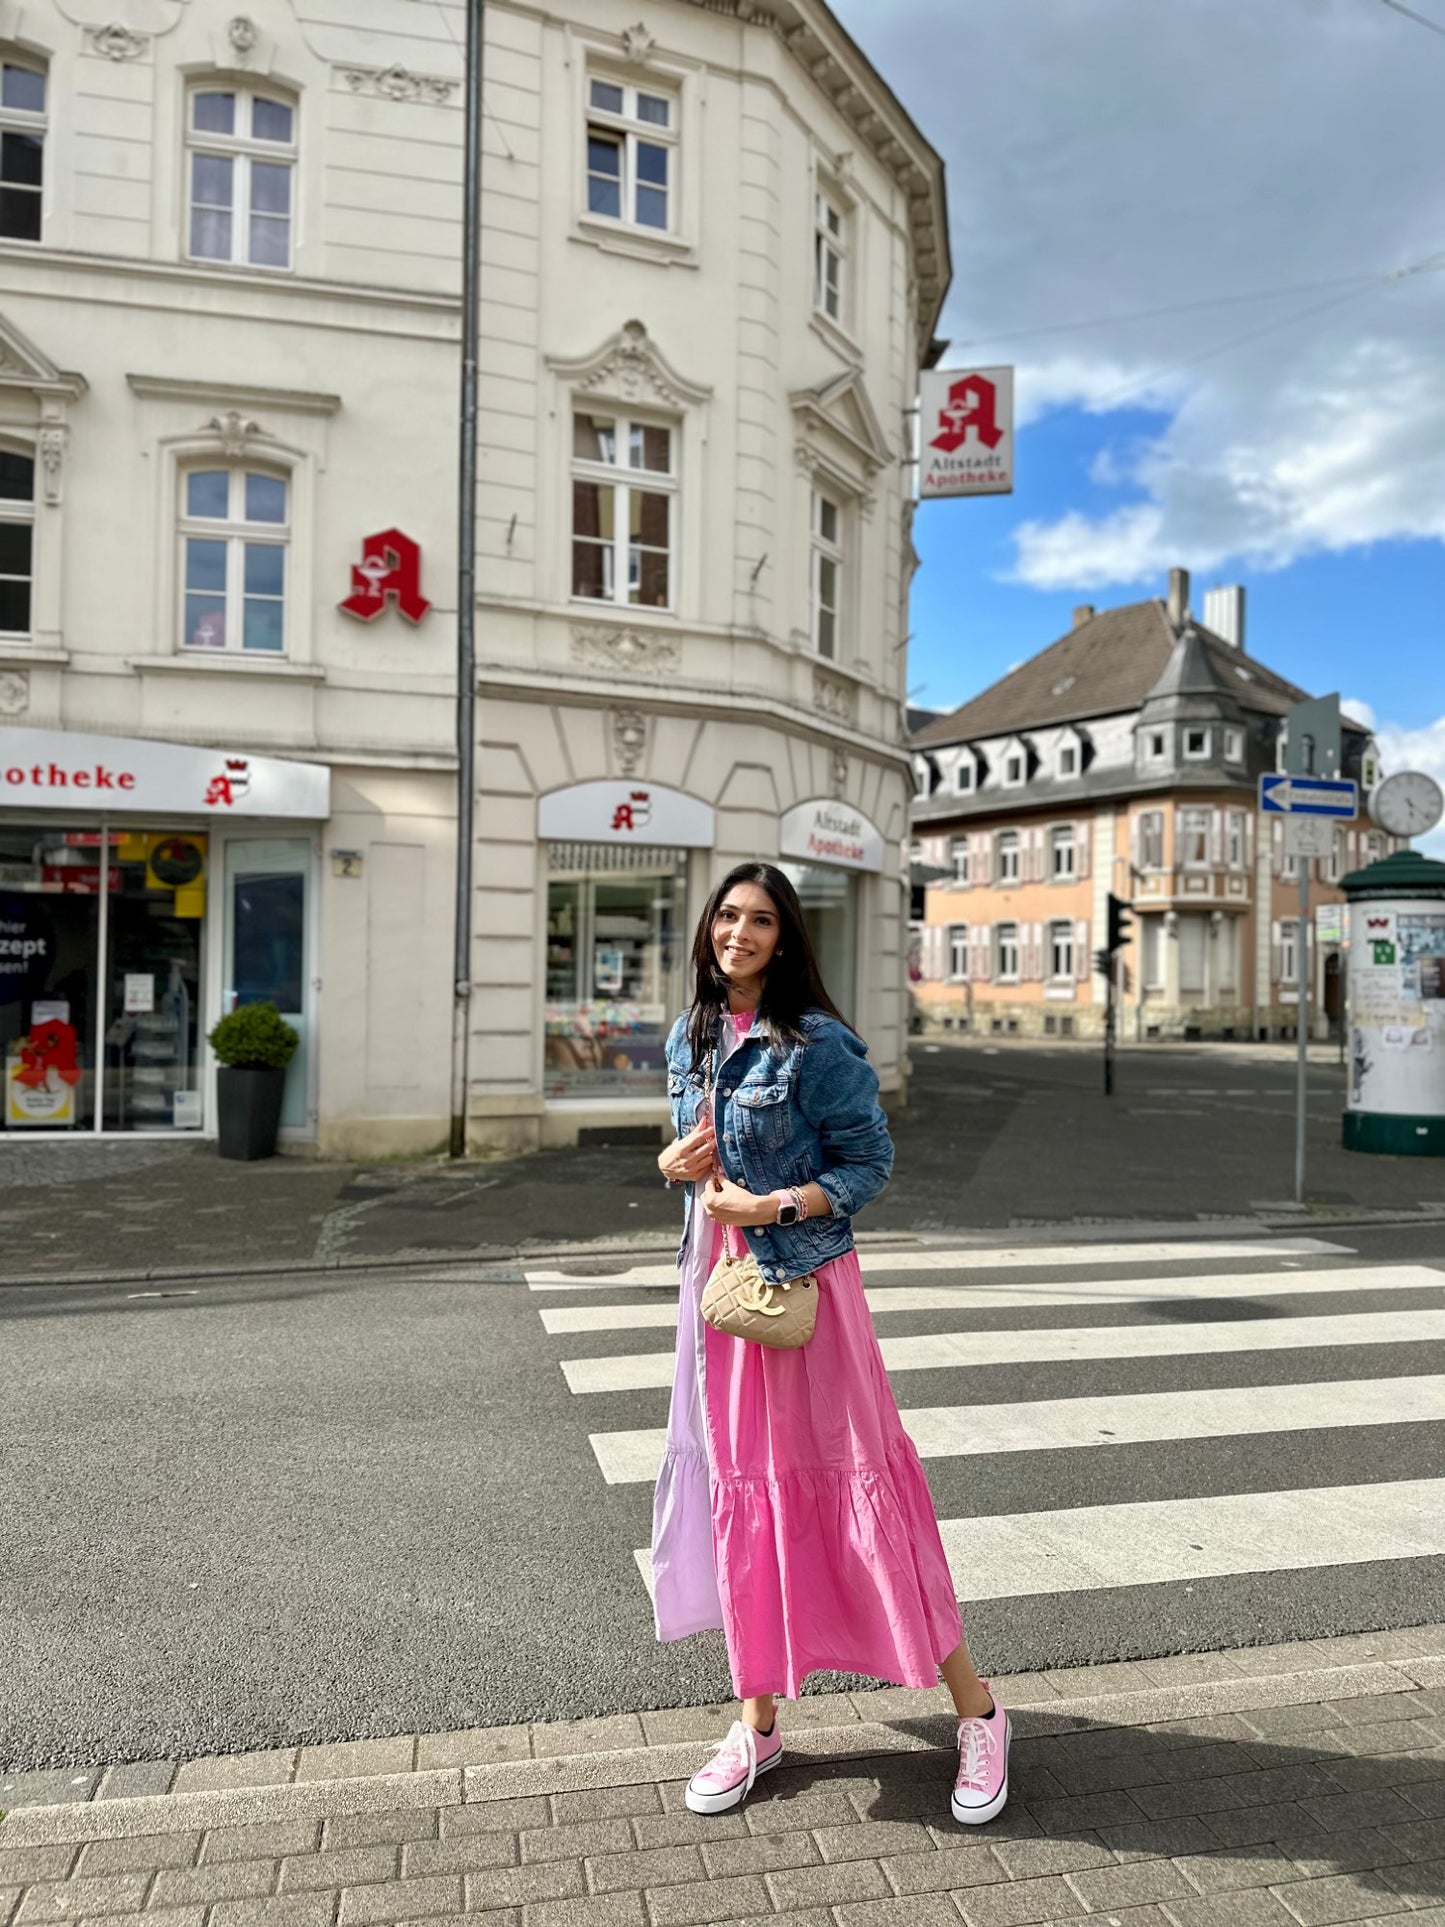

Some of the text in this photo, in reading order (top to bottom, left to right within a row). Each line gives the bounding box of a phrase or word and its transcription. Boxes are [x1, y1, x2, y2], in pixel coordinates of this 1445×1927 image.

[930, 455, 1002, 471] Altstadt
[925, 470, 1008, 488] Apotheke
[0, 763, 136, 790] otheke
[341, 858, 352, 876] 2
